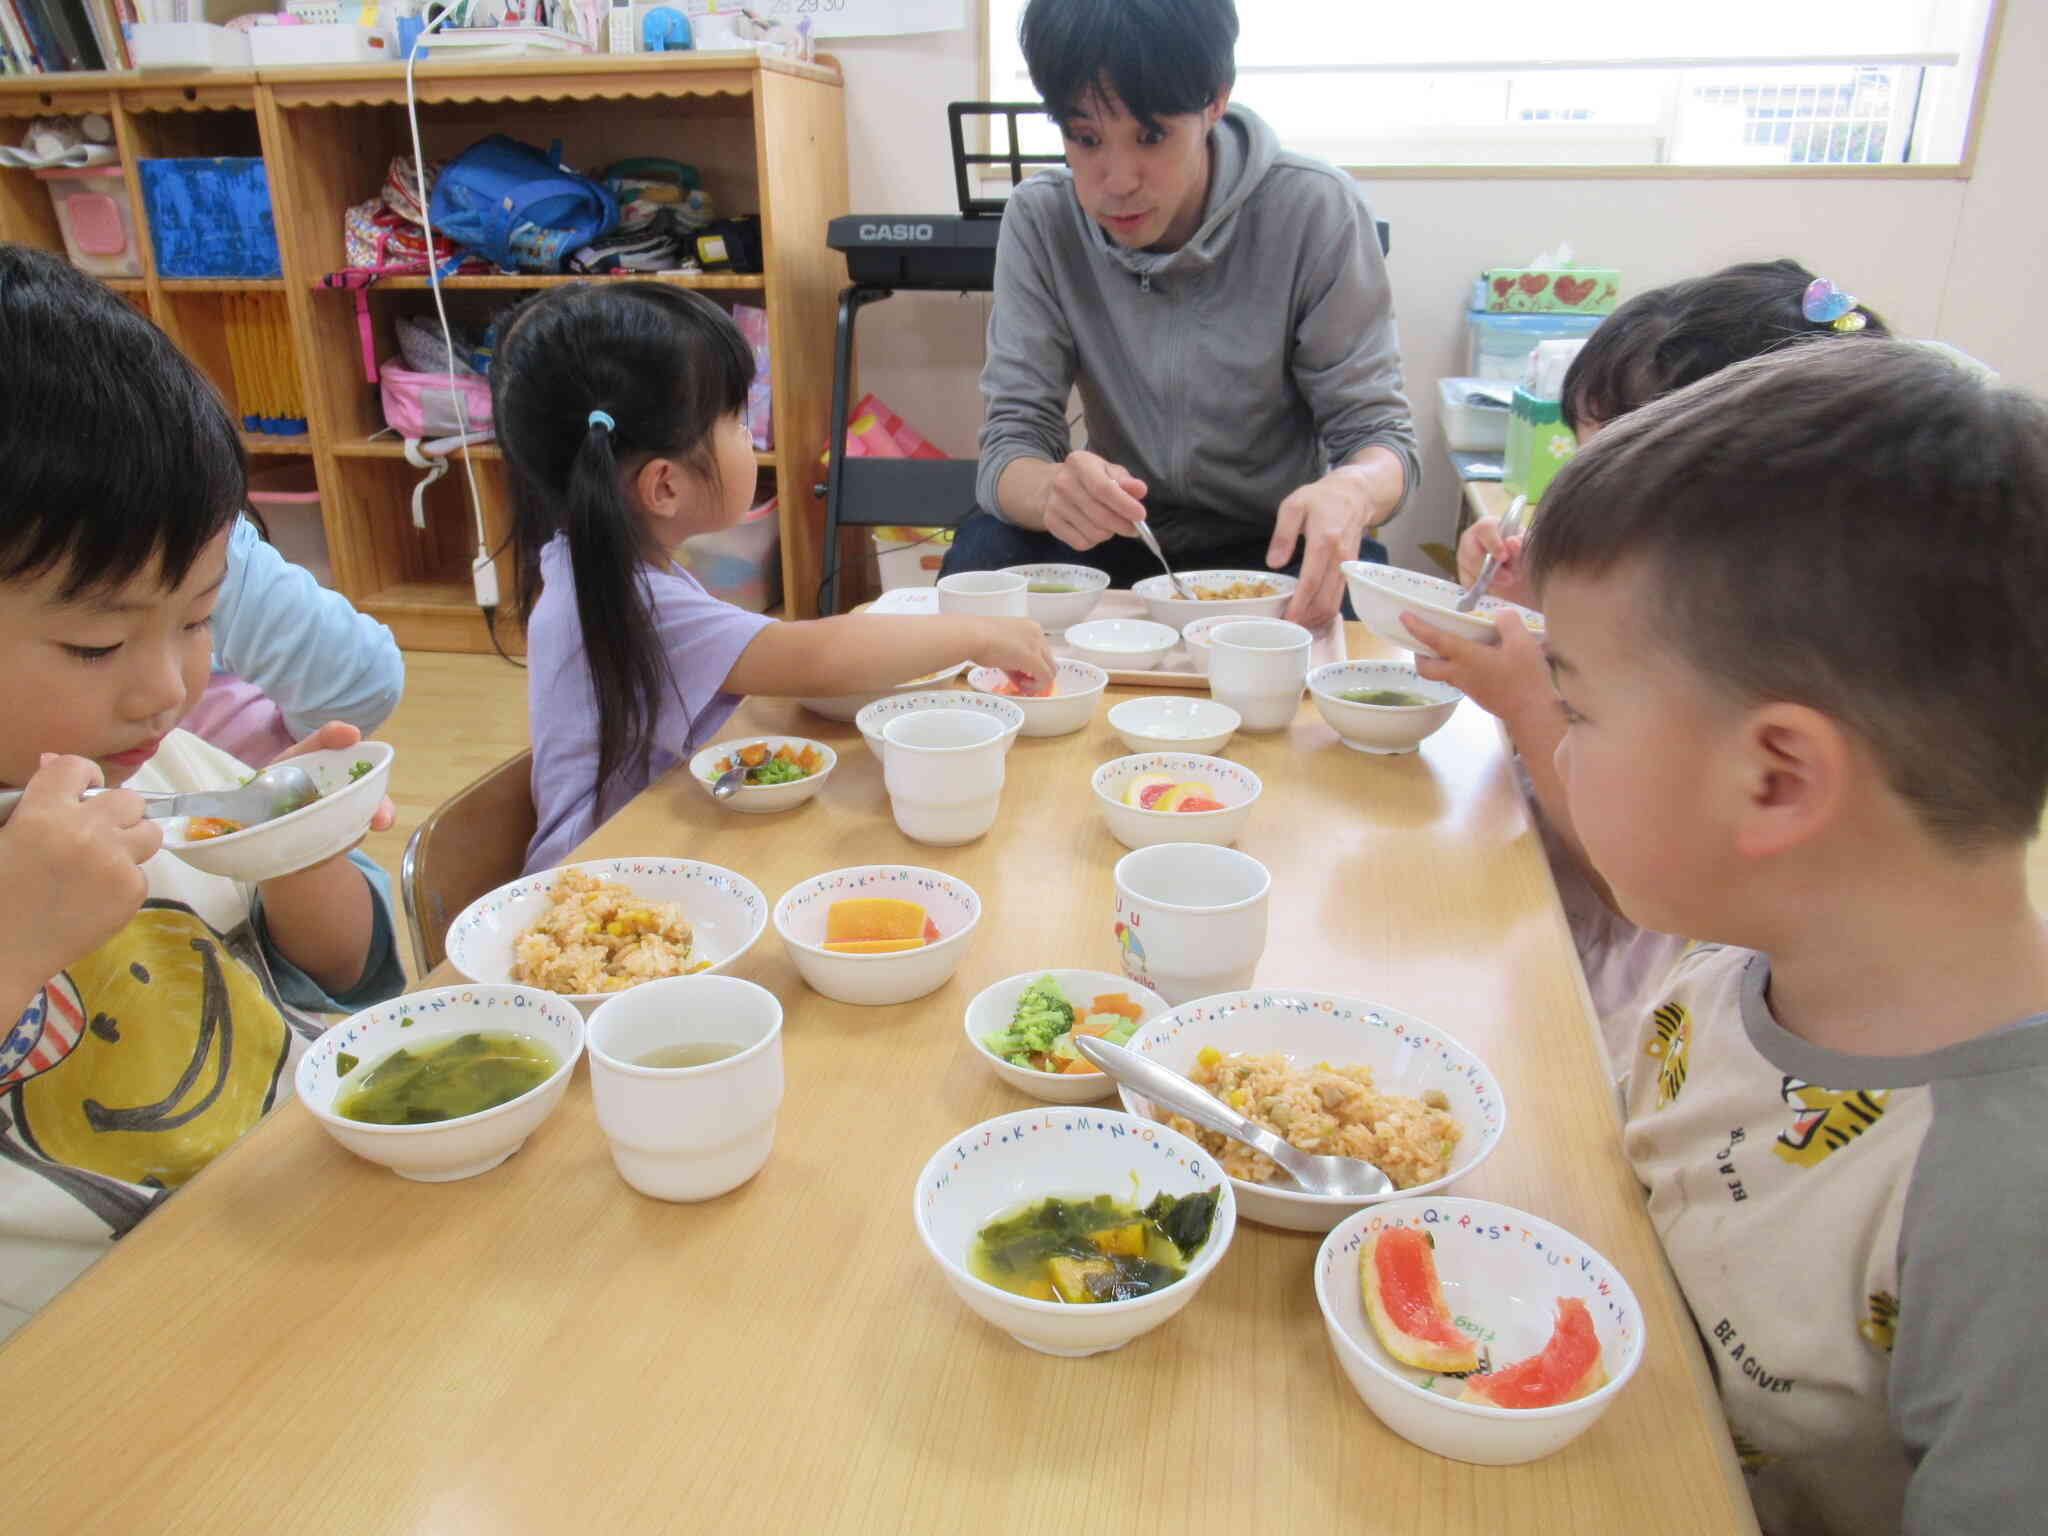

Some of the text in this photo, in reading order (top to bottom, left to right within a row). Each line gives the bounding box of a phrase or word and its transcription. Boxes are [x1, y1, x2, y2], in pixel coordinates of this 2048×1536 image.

[859, 223, 934, 241] CASIO
[1720, 1162, 1735, 1175] A
[1728, 1181, 1746, 1202] BE
[1713, 1318, 1794, 1393] BE A GIVER
